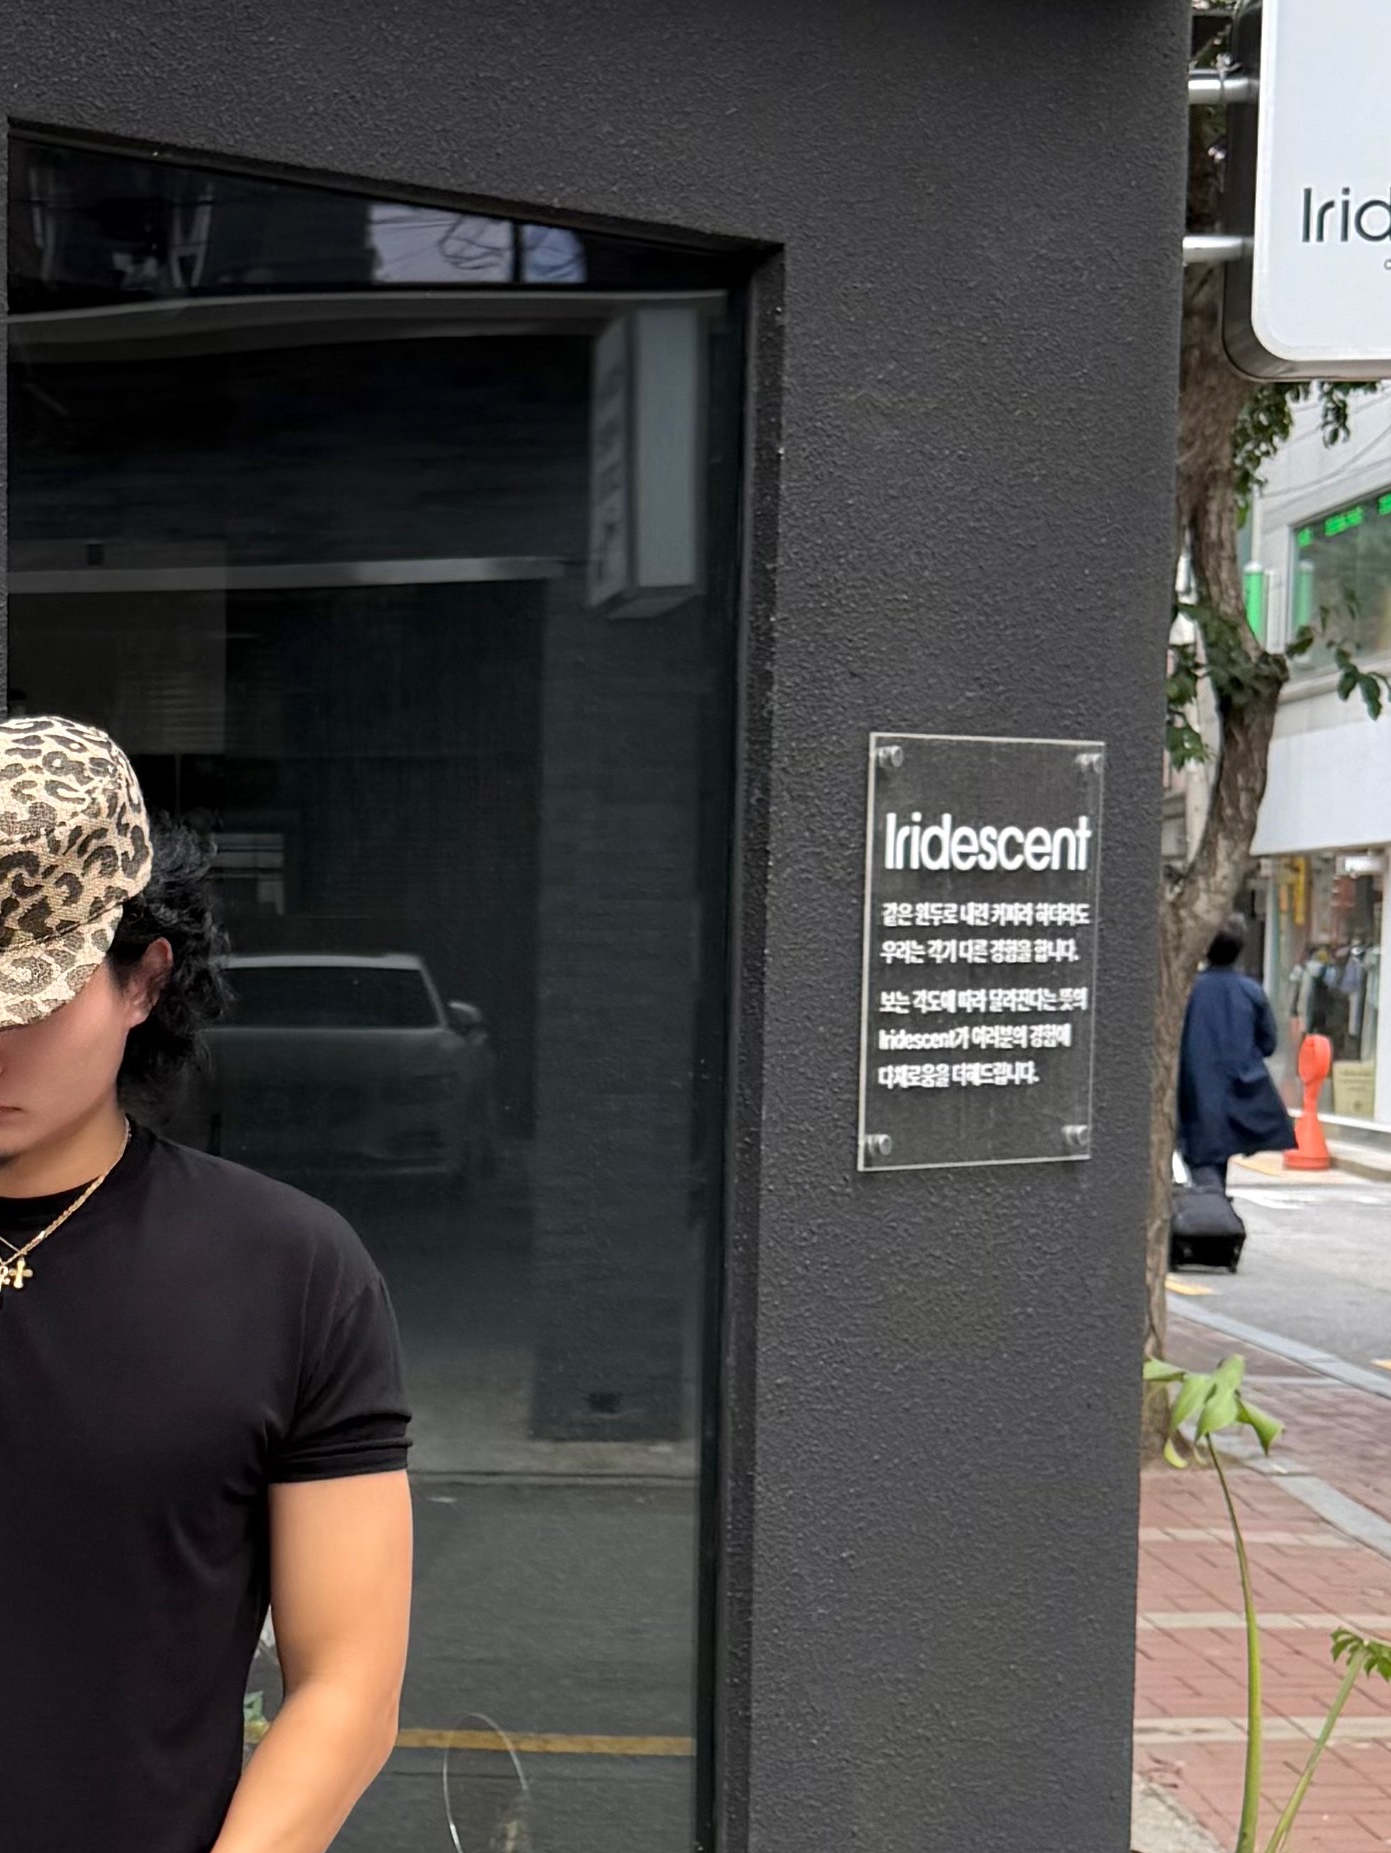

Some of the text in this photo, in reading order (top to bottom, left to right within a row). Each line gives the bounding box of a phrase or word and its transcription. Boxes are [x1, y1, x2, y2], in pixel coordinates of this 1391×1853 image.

[885, 812, 1092, 871] Iridescent
[882, 902, 1090, 927] 같은 원두로 내린 커피라 하더라도
[880, 938, 1080, 964] 우리는 각기 다른 경험을 합니다.
[879, 987, 1088, 1014] 보는 각도에 따라 달라진다는 뜻의
[879, 1023, 1071, 1050] Iridescent가 여러분의 경험에
[878, 1061, 1040, 1089] 다채로움을 더해드립니다.
